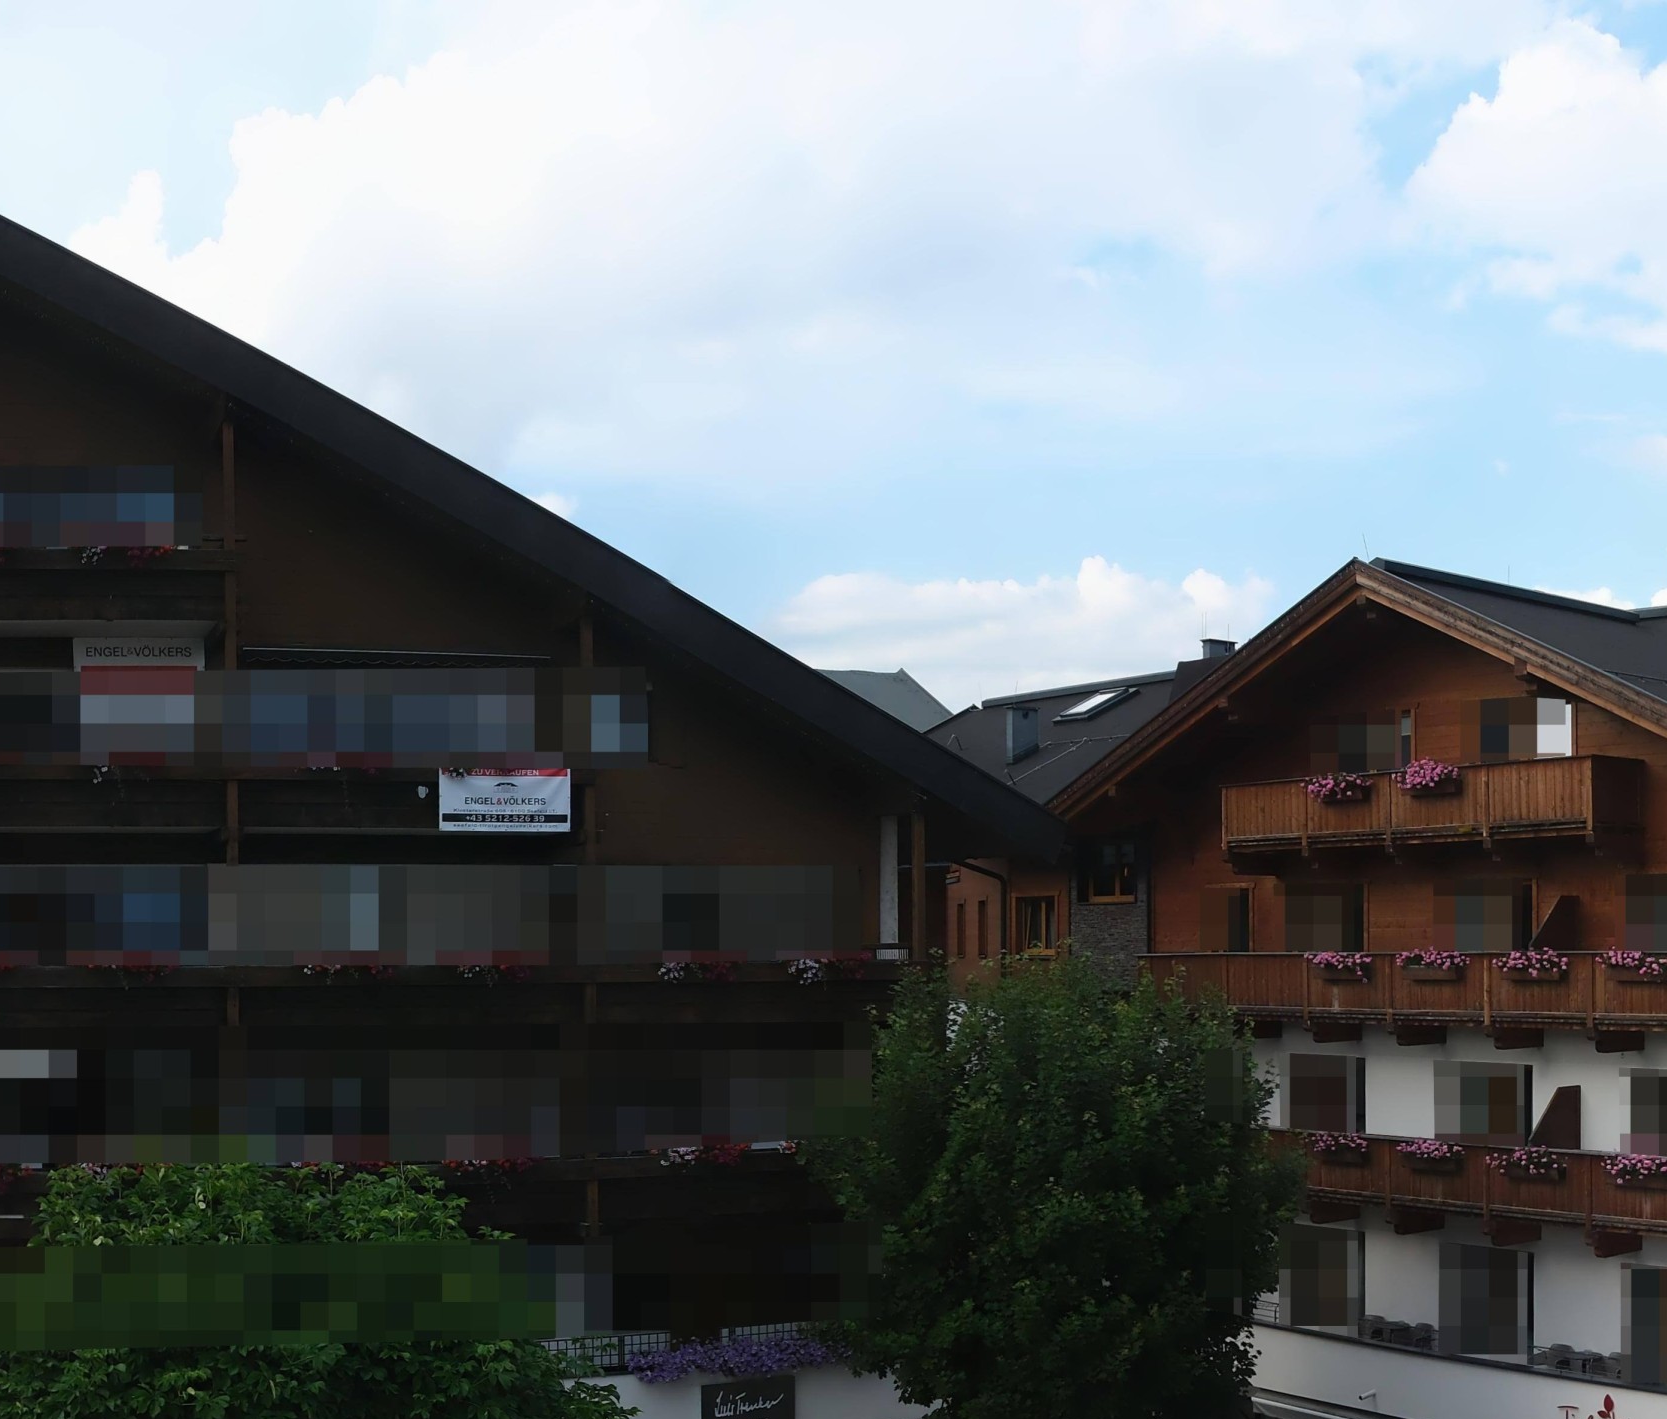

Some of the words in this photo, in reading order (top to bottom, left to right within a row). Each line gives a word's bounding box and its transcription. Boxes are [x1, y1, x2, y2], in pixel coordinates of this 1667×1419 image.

[85, 644, 192, 658] ENGEL&VÖLKERS
[464, 796, 546, 806] ENGEL&VÖLKERS
[466, 814, 482, 822] +43
[485, 814, 530, 822] 5212-526
[735, 1392, 784, 1415] Trenker
